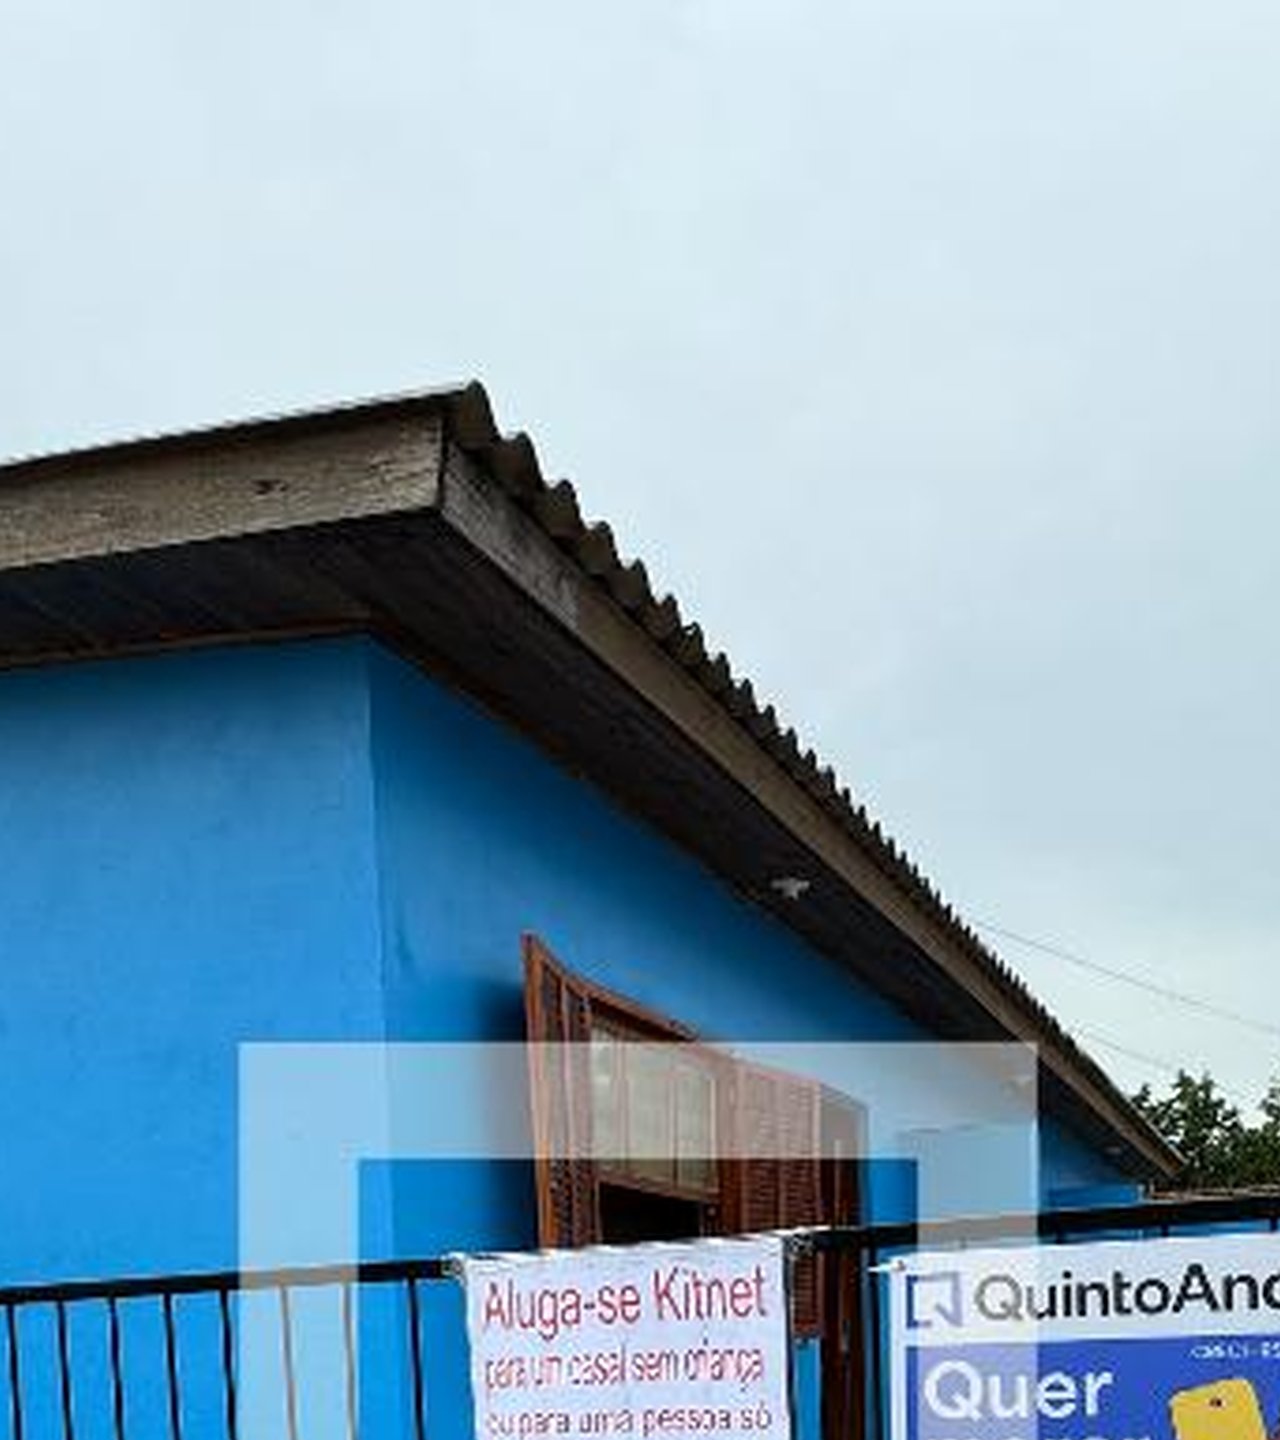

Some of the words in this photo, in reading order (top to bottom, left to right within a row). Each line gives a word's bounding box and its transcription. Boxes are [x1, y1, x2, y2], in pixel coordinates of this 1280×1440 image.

[484, 1277, 641, 1341] Aluga-se
[652, 1265, 768, 1321] Kitnet
[570, 1343, 626, 1386] casal
[632, 1350, 679, 1382] sem
[685, 1337, 763, 1392] criança
[924, 1359, 1114, 1422] Quer
[519, 1410, 570, 1440] para
[579, 1408, 633, 1434] uma
[642, 1408, 731, 1437] pessoa
[740, 1399, 773, 1430] só
